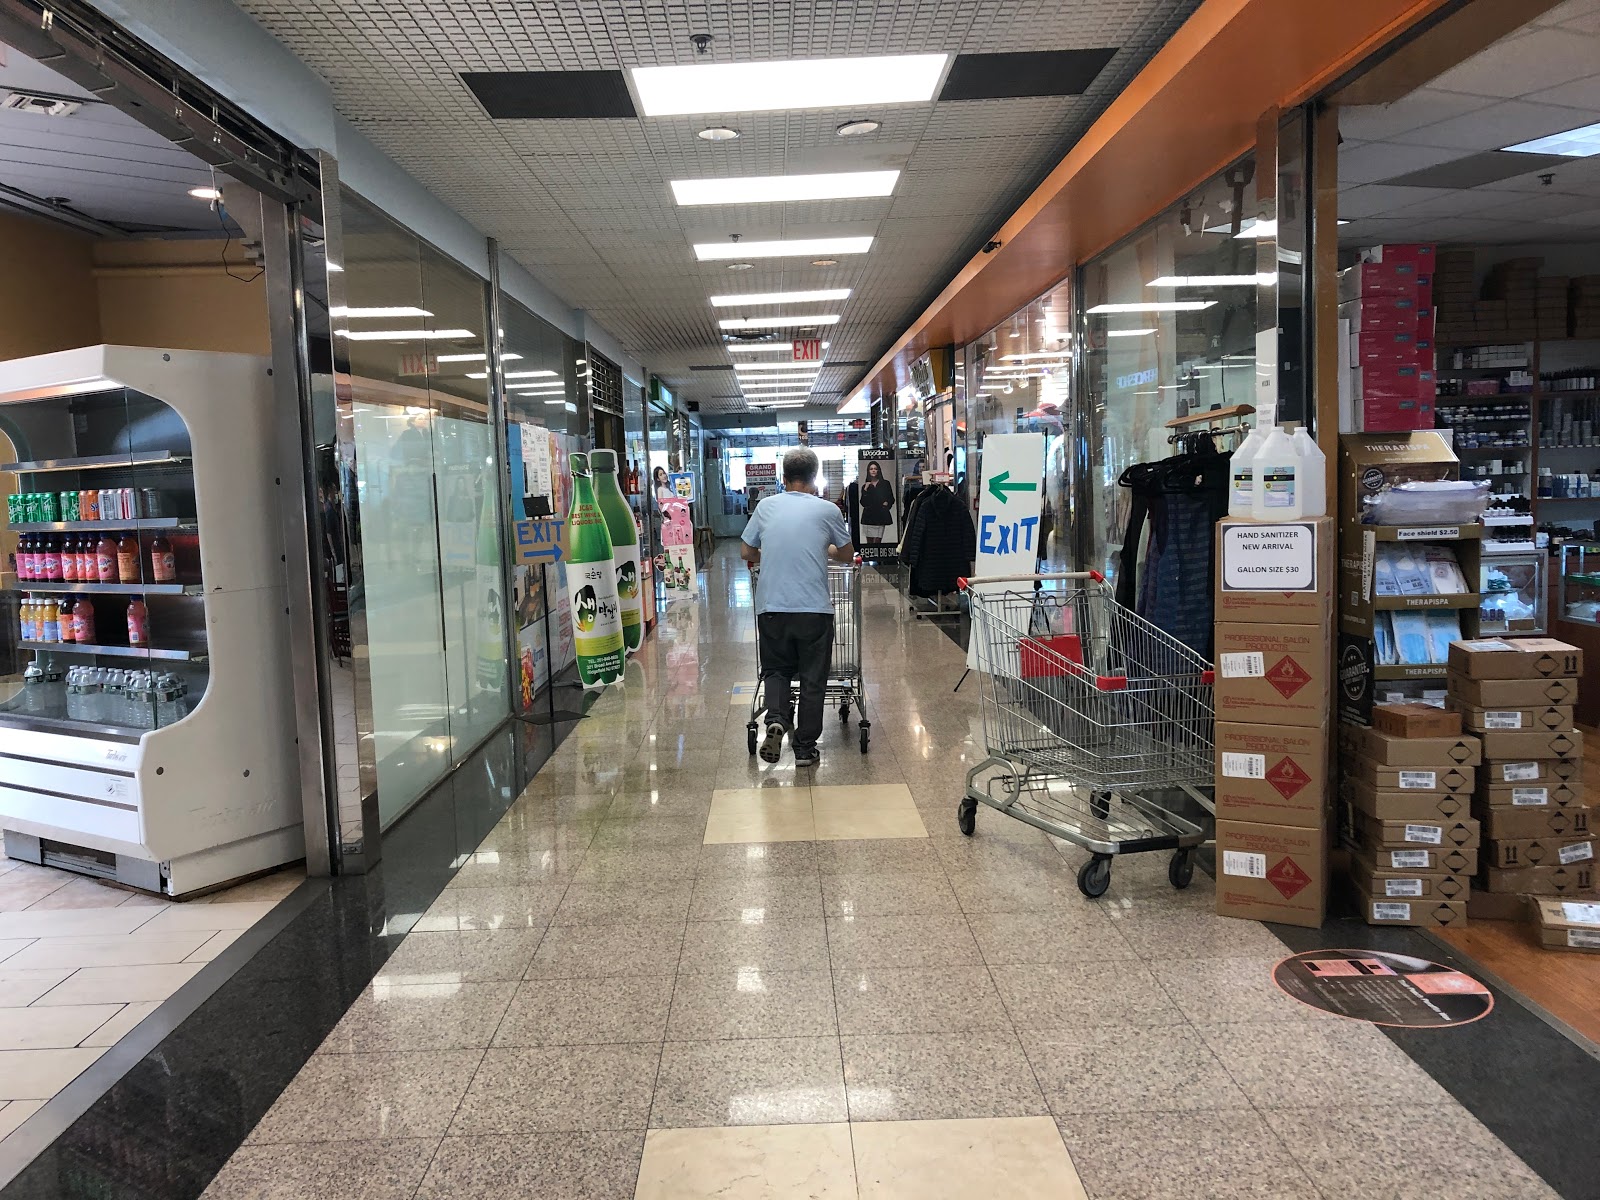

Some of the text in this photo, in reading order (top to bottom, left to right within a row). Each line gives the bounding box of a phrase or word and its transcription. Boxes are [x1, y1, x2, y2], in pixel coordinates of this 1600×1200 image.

[793, 339, 821, 360] EXIT
[1364, 443, 1431, 452] THERAPISPA
[517, 521, 565, 545] EXIT
[980, 515, 1039, 556] EXIT
[880, 548, 888, 557] BIG
[575, 592, 595, 623] 생
[1406, 598, 1449, 606] THERAPISPA
[1224, 634, 1310, 644] PROFESSIONAL SALON
[1245, 643, 1288, 651] PRODUCTS
[1224, 733, 1311, 746] PROFESSIONAL SALON
[1245, 742, 1289, 752] PRODUCTS
[1225, 831, 1311, 847] PROFESSIONAL SALON
